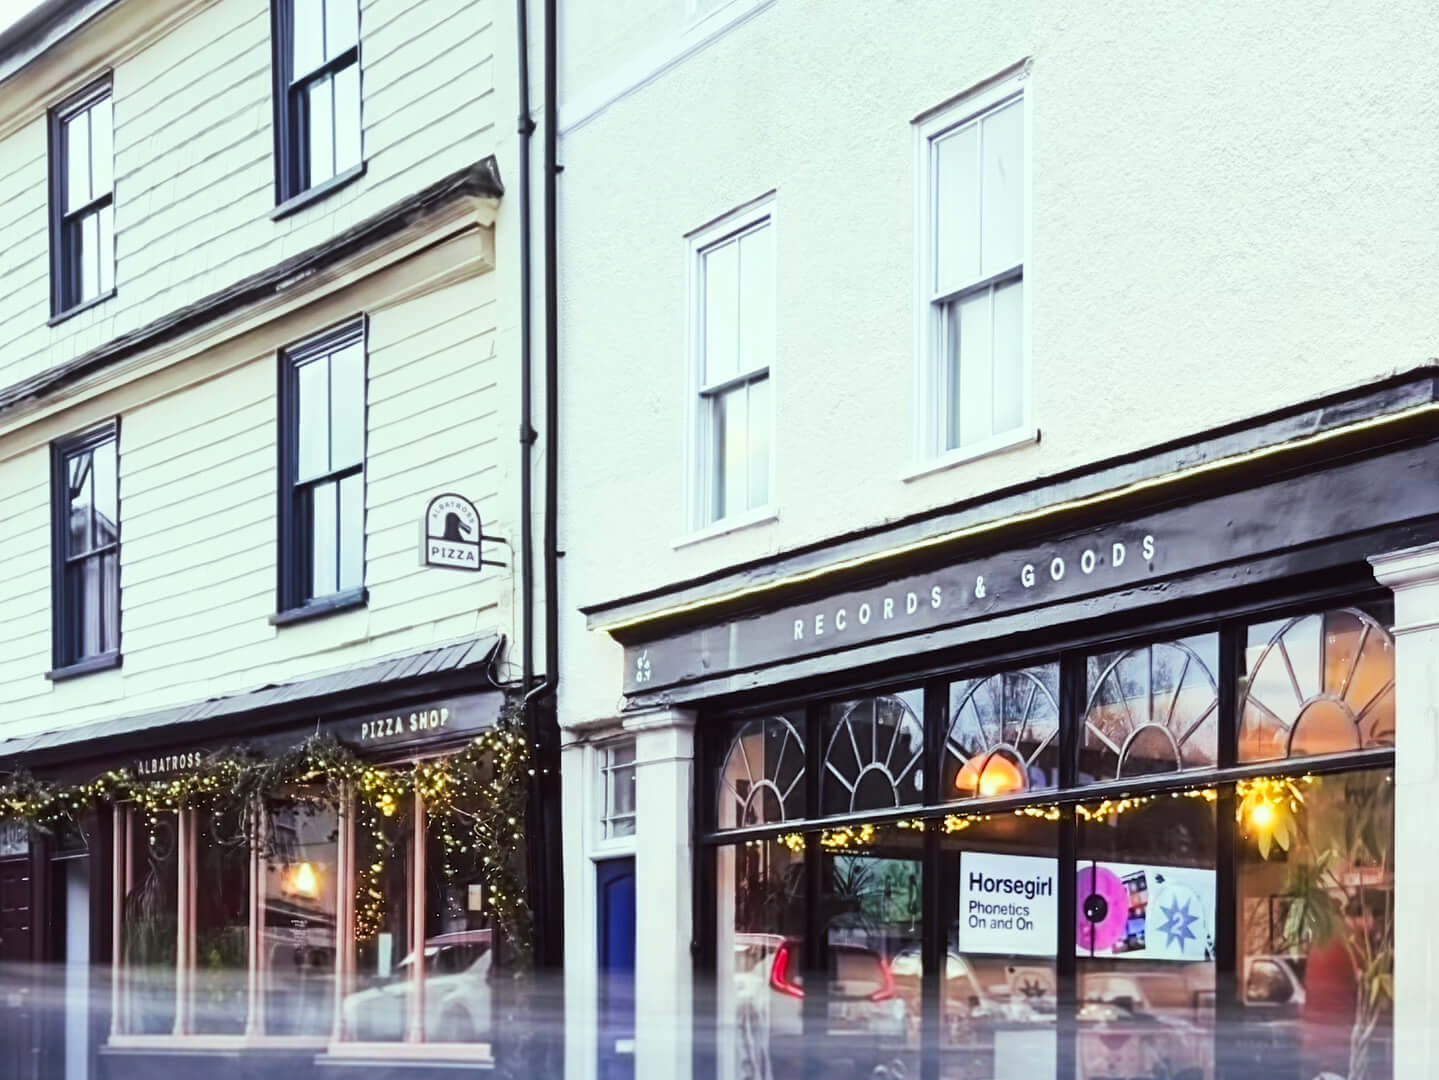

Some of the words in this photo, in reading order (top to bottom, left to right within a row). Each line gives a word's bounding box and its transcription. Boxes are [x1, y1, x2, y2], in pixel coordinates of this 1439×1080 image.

[432, 546, 474, 561] PIZZA
[794, 586, 942, 640] RECORDS
[974, 576, 986, 599] &
[1021, 535, 1155, 588] GOODS
[362, 716, 404, 740] PIZZA
[410, 707, 449, 732] SHOP
[138, 751, 202, 776] ALBATROSS
[969, 871, 1053, 900] Horsegirl
[968, 900, 1030, 916] Phonetics
[968, 915, 986, 929] On
[990, 917, 1013, 930] and
[1016, 917, 1034, 931] On
